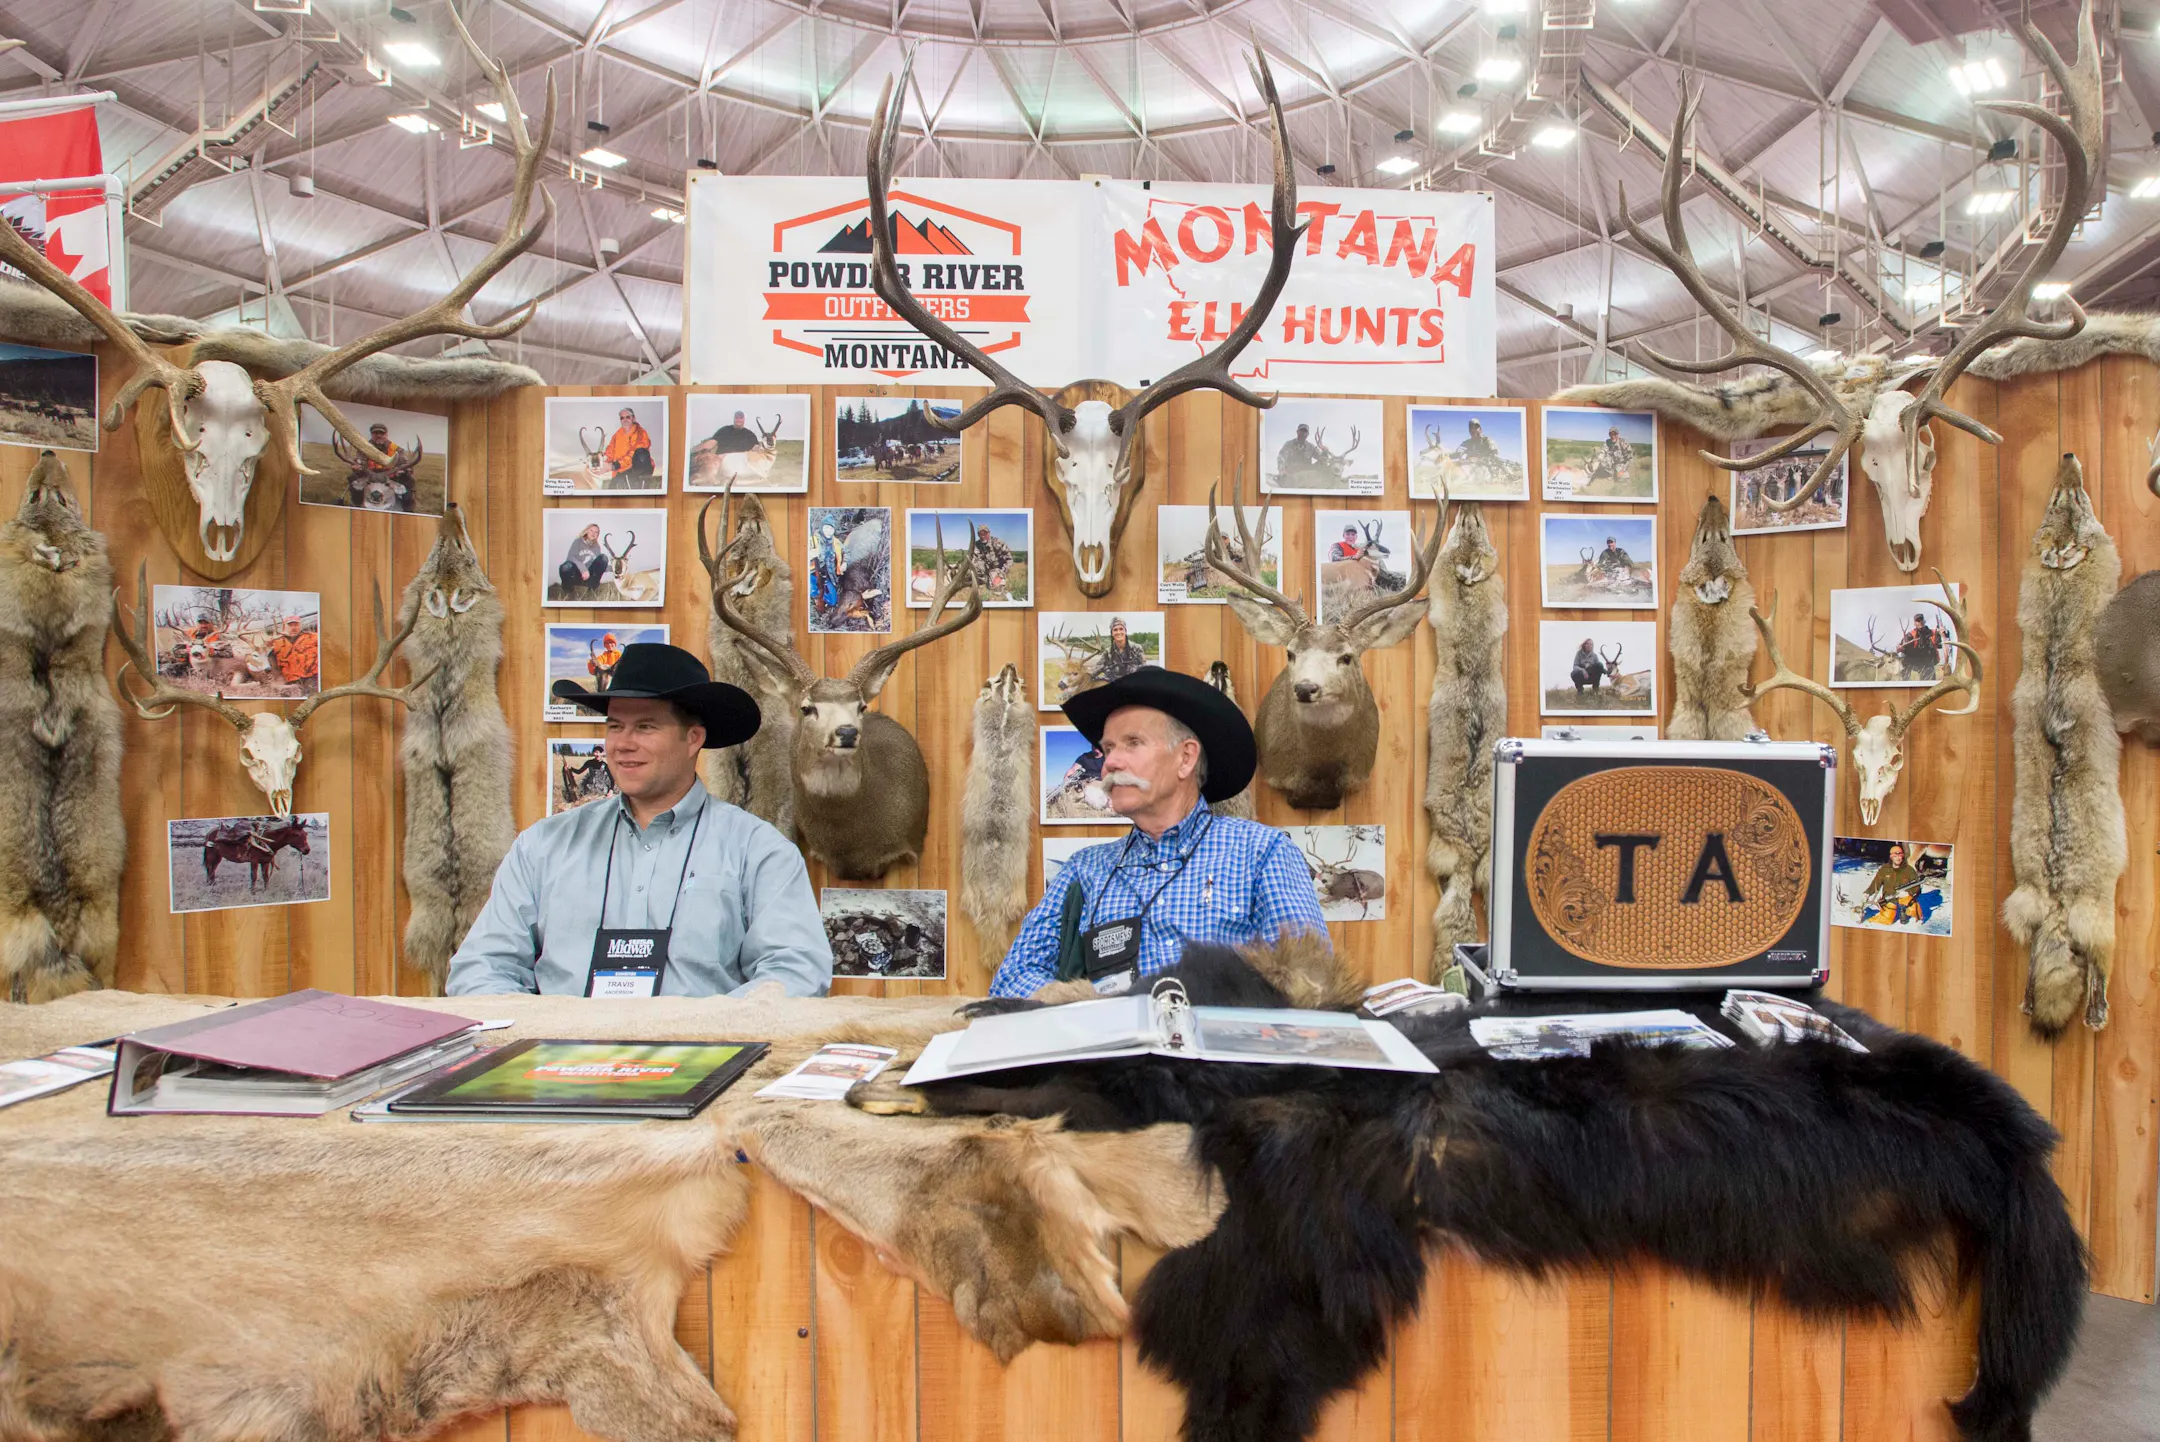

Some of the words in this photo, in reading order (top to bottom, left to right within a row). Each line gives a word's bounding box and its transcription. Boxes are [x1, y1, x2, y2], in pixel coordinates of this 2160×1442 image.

[768, 261, 912, 289] POWDR
[922, 264, 1025, 291] RIVER
[825, 296, 970, 319] OUTFIERS
[1281, 304, 1445, 348] HUNTS
[607, 939, 654, 958] Midway
[533, 1065, 614, 1073] POWDER
